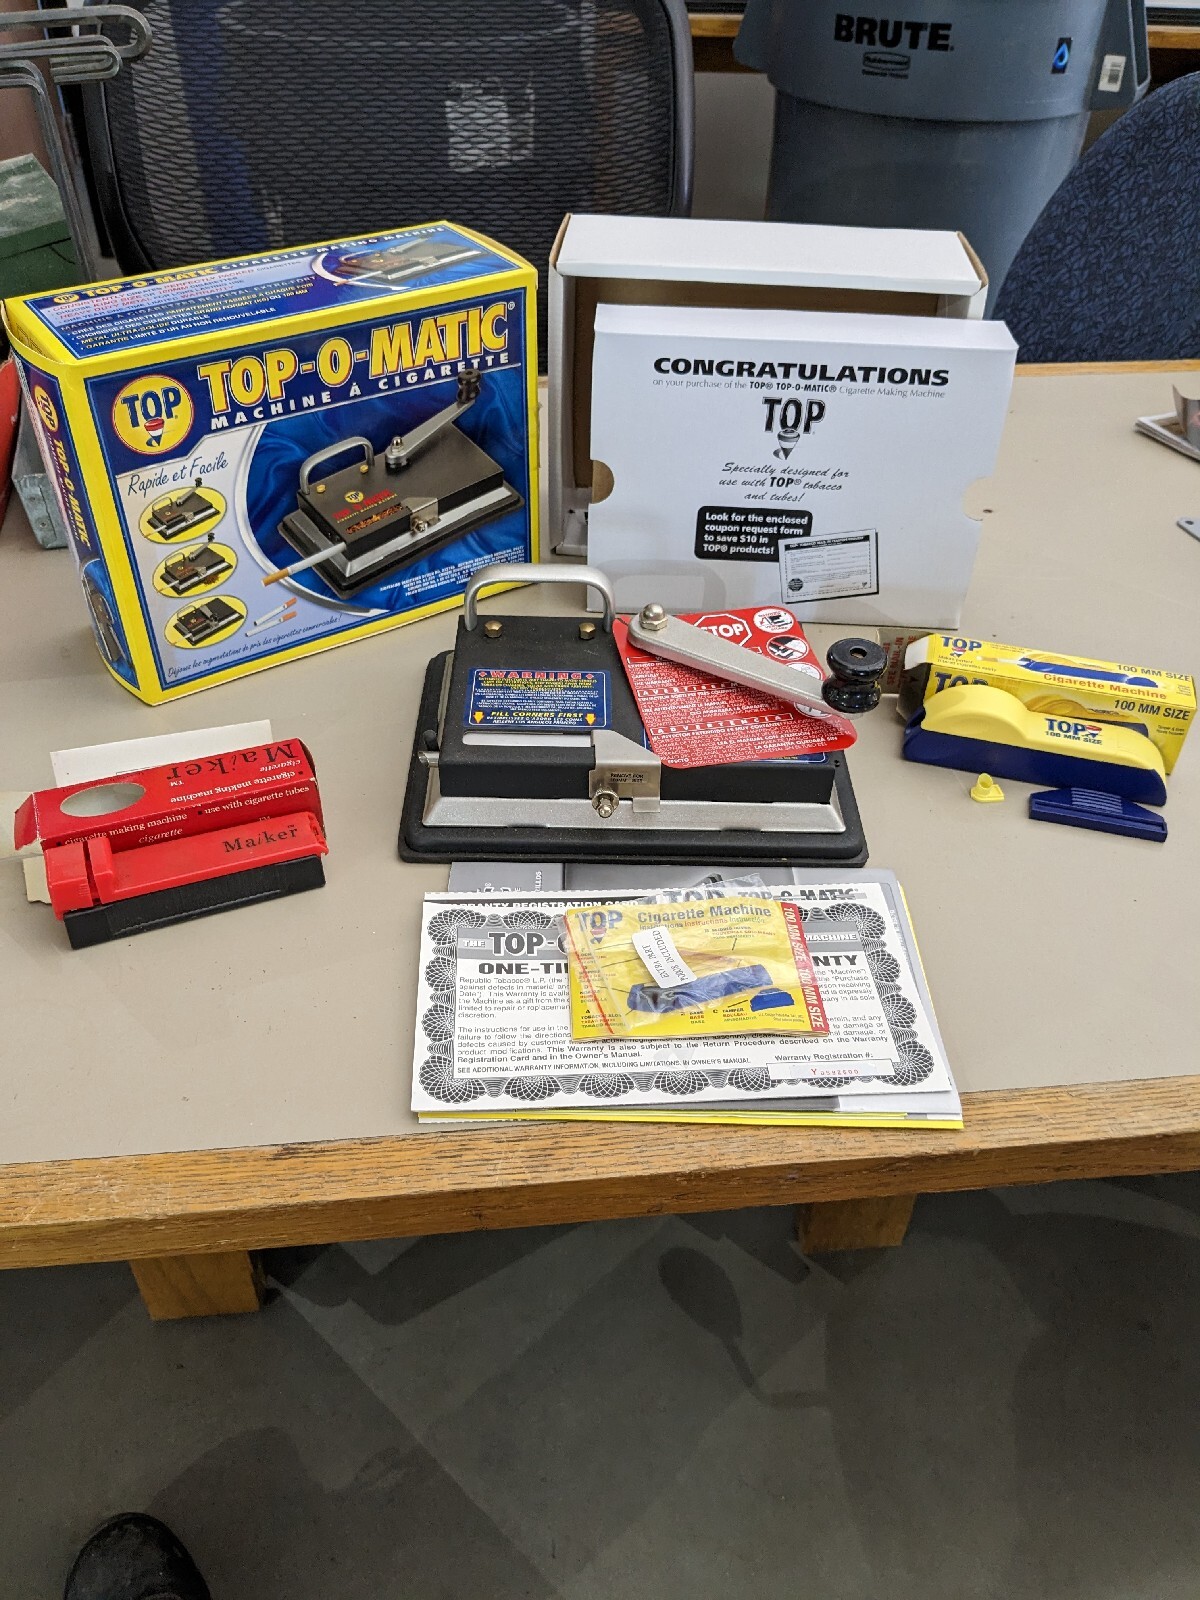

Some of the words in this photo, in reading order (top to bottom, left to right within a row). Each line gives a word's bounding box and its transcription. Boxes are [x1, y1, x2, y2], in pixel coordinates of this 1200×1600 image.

[653, 356, 950, 387] CONGRATULATIONS
[211, 391, 332, 431] MACHINE
[378, 352, 509, 390] CIGARETTE
[665, 379, 684, 389] your
[686, 379, 722, 389] purchase
[723, 380, 734, 389] of
[734, 380, 748, 389] the
[838, 385, 876, 397] Cigarette
[877, 387, 908, 398] Making
[909, 388, 946, 399] Machine
[120, 386, 182, 429] TOP
[761, 396, 827, 435] TOP
[127, 467, 170, 498] Rapide
[172, 464, 188, 482] et
[189, 451, 229, 479] Facile
[721, 461, 777, 475] Specially
[780, 465, 830, 478] designed
[830, 467, 850, 480] for
[718, 478, 738, 486] use
[741, 477, 767, 487] with
[803, 481, 843, 491] tobacco
[744, 492, 766, 501] and
[769, 492, 806, 502] tubes!
[705, 512, 729, 522] Look
[730, 513, 746, 522] for
[747, 513, 764, 523] the
[765, 515, 809, 525] enclosed
[703, 533, 714, 542] to
[716, 535, 738, 543] save
[739, 534, 757, 544] $10
[759, 535, 769, 544] in
[704, 524, 740, 534] coupon
[741, 525, 778, 536] request
[779, 526, 804, 536] form
[729, 544, 775, 555] products!
[202, 648, 241, 667] augmentations
[242, 643, 250, 652] de
[250, 640, 262, 652] prix
[263, 636, 272, 645] des
[272, 628, 301, 645] cigarettes
[941, 635, 983, 652] TOP
[490, 671, 582, 680] WARNING
[1117, 663, 1138, 673] 100
[1140, 667, 1163, 677] MM
[1165, 672, 1192, 682] SIZE
[935, 670, 989, 694] TO
[1043, 673, 1105, 690] Cigarette
[1109, 685, 1168, 700] Machine
[1114, 699, 1136, 711] 100
[1137, 703, 1161, 716] MM
[1162, 707, 1191, 721] SIZE
[658, 715, 783, 734] ADVERTENCIA
[1044, 717, 1086, 736] TOP
[1045, 730, 1061, 738] 100
[1064, 734, 1081, 742] MM
[1083, 737, 1103, 746] SIZE
[259, 758, 301, 772] cigarette
[253, 770, 296, 786] cigarette
[214, 780, 253, 794] making
[170, 789, 214, 804] machine
[109, 822, 146, 836] making
[147, 812, 188, 828] machine
[204, 806, 221, 815] use
[222, 799, 244, 812] with
[244, 790, 285, 807] cigarette
[285, 784, 310, 797] tubes
[138, 826, 184, 843] cigarette
[574, 909, 624, 933] TOP
[637, 906, 706, 925] Cigarette
[709, 903, 772, 918] Machine
[783, 907, 797, 922] 100
[683, 918, 728, 928] Instructions
[787, 923, 802, 941] MM
[804, 933, 858, 942] MACHINE
[462, 938, 486, 948] THE
[792, 942, 807, 963] SIZE
[478, 962, 569, 975] ONE-TI
[799, 968, 813, 985] 100
[459, 976, 492, 985] Republic
[459, 984, 486, 992] against
[505, 990, 539, 999] Warranty
[803, 985, 818, 1004] MM
[458, 1004, 483, 1012] limited
[493, 1004, 516, 1012] repair
[808, 1006, 825, 1029] SIZE
[457, 1033, 482, 1041] failure
[494, 1033, 517, 1041] follow
[474, 1025, 518, 1033] instructions
[566, 1044, 607, 1054] Warranty
[619, 1043, 637, 1051] also
[640, 1042, 671, 1052] subject
[702, 1040, 731, 1048] Return
[733, 1038, 776, 1047] Procedure
[779, 1037, 820, 1046] described
[851, 1035, 888, 1044] Warranty
[457, 1055, 508, 1064] Registration
[574, 1051, 609, 1060] Owner's
[610, 1050, 644, 1059] Manual.
[774, 1053, 812, 1062] Warranty
[812, 1051, 864, 1061] Registration
[472, 1065, 514, 1074] ADDITIONAL
[513, 1064, 552, 1072] WARRANTY
[722, 1057, 751, 1065] MANUAL
